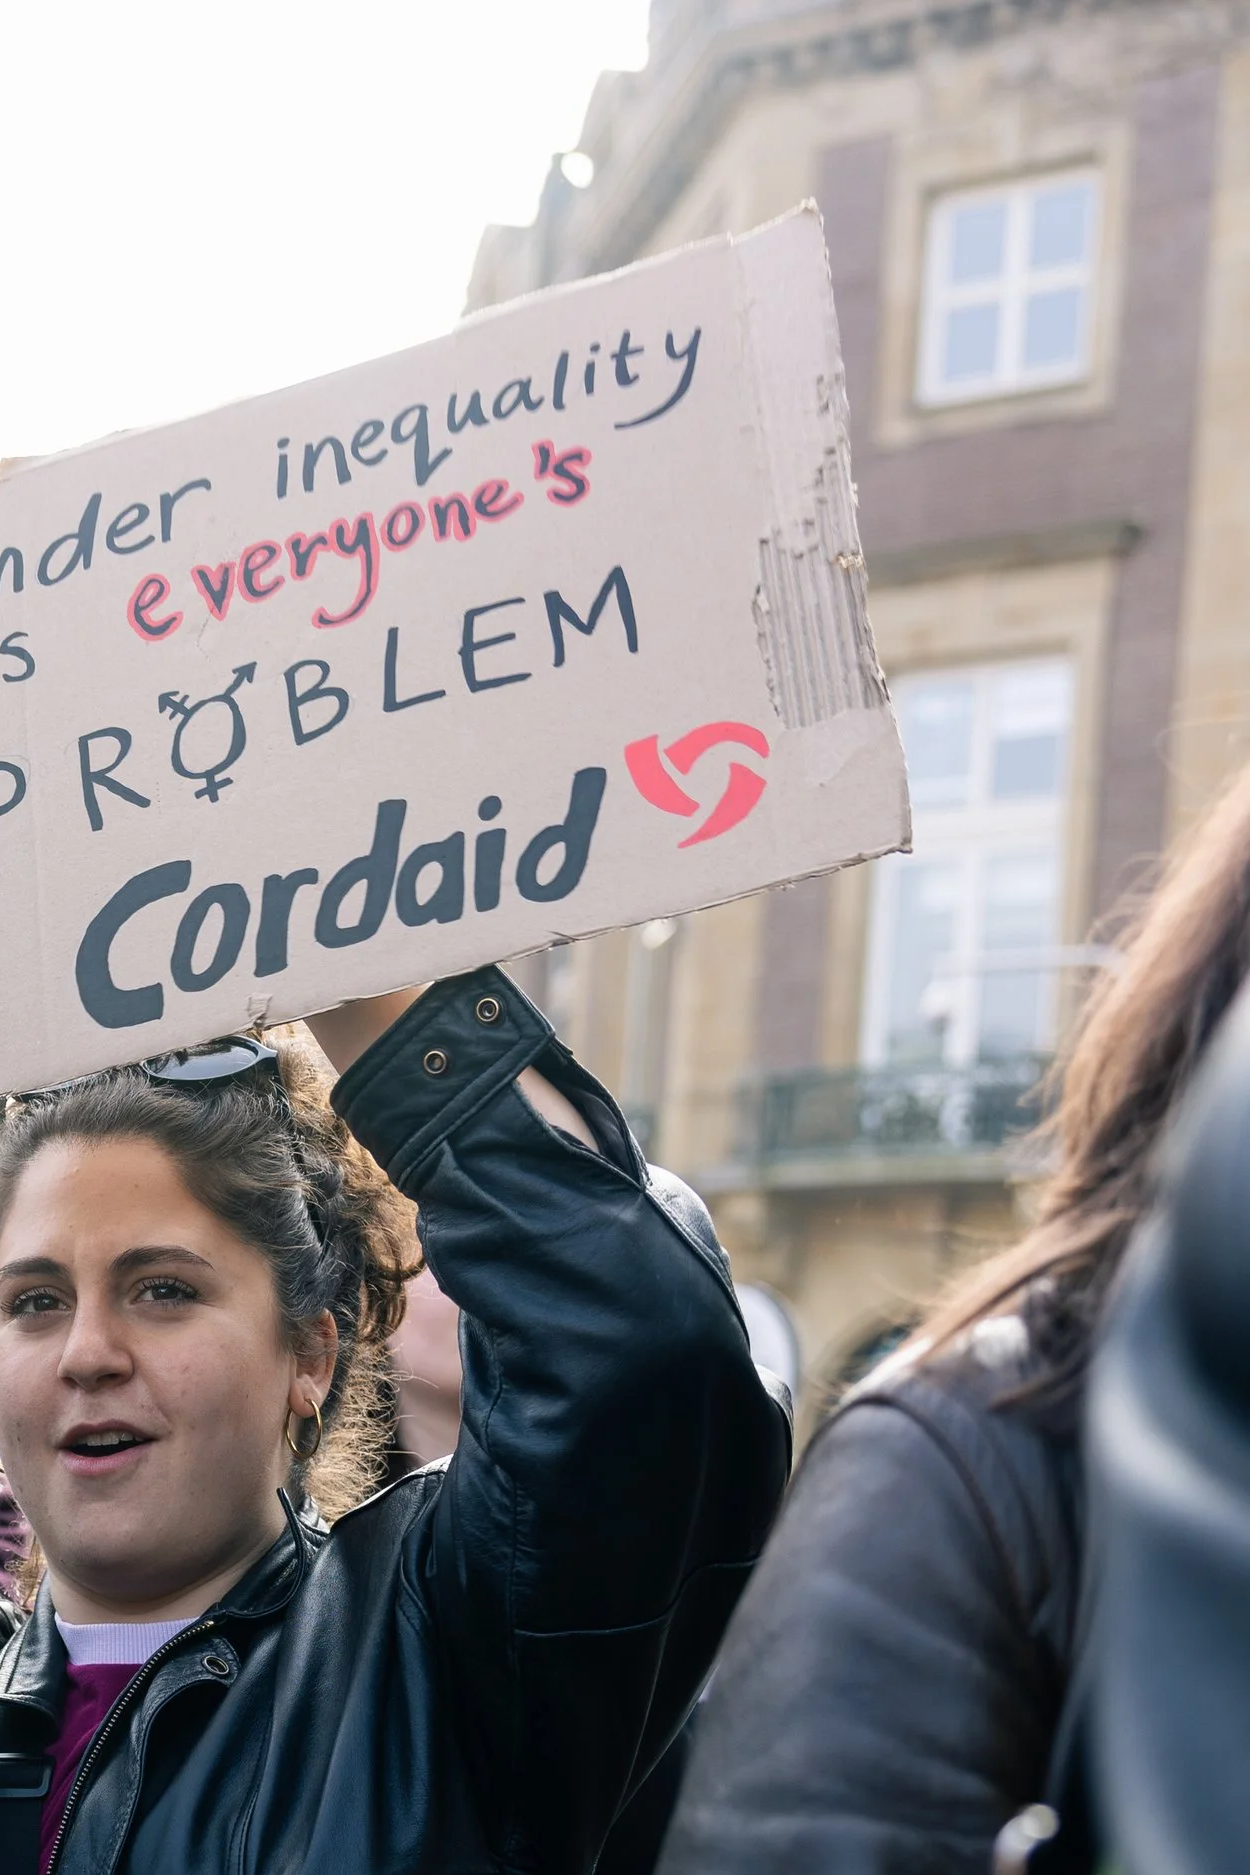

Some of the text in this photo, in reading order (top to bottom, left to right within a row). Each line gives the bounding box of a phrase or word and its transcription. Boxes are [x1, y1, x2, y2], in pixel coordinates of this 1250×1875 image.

[275, 326, 702, 501] inequality
[126, 438, 593, 643] everyone's
[75, 766, 608, 1030] Cordaid
